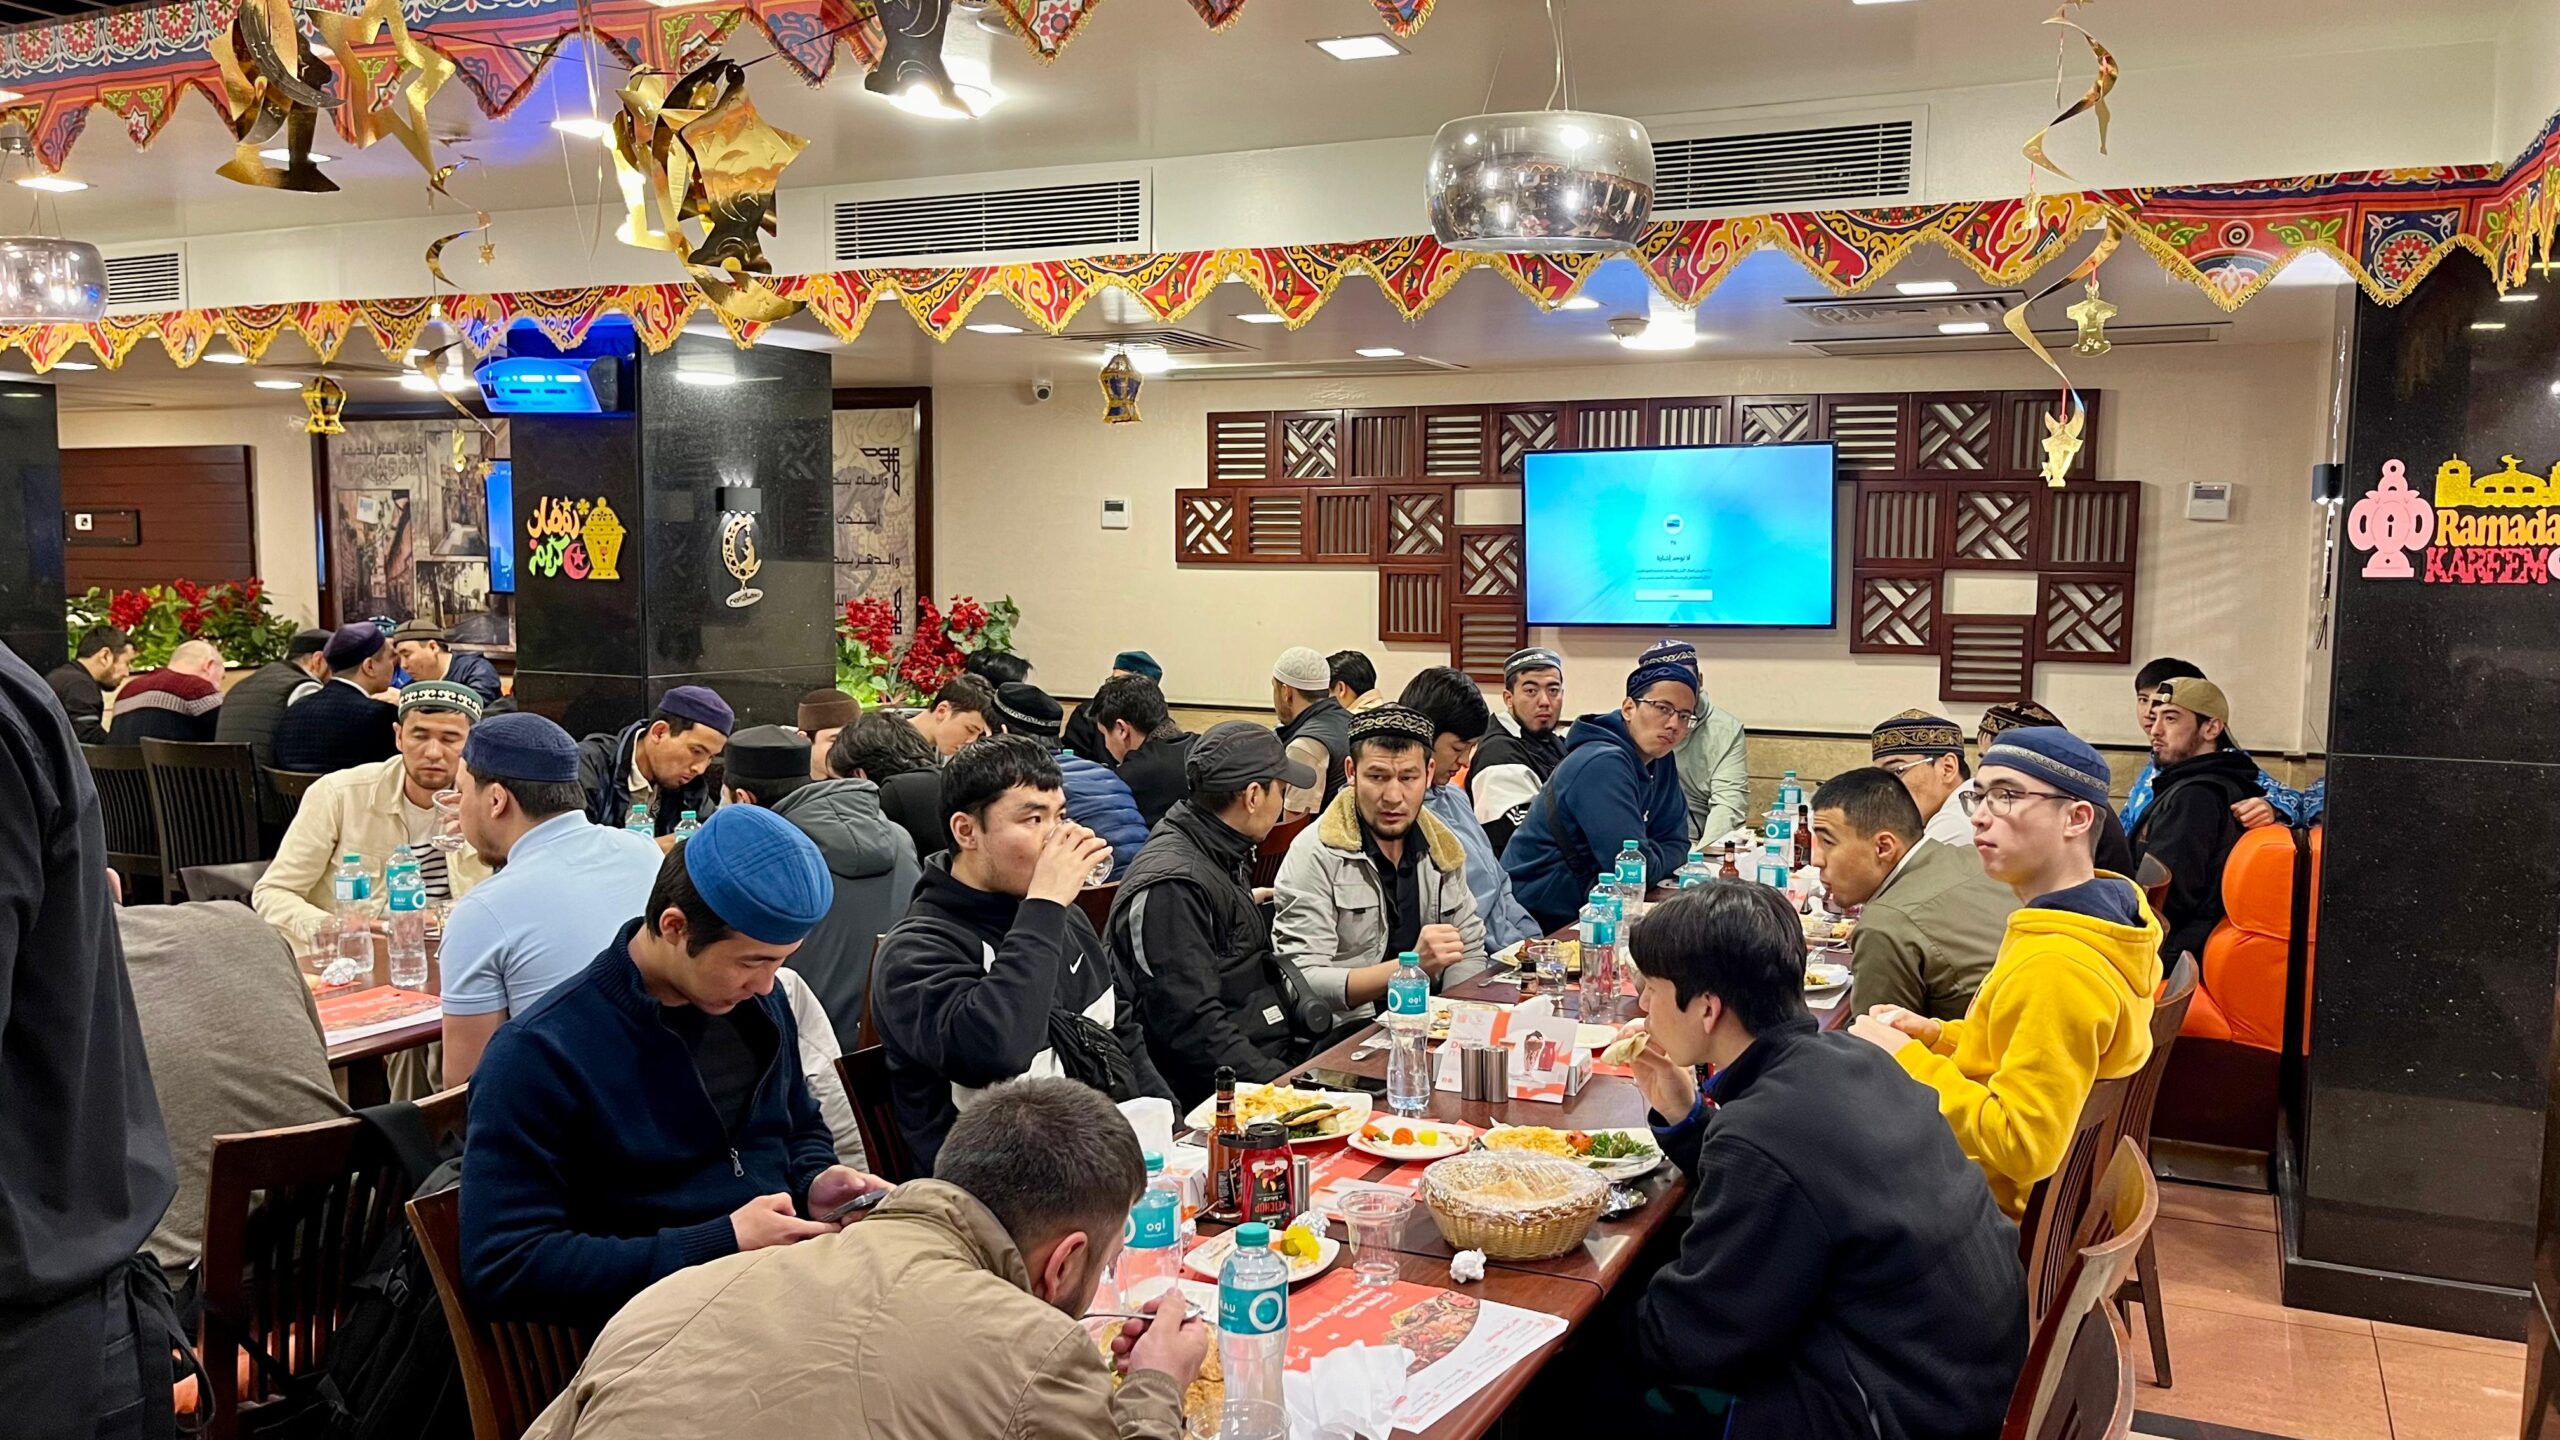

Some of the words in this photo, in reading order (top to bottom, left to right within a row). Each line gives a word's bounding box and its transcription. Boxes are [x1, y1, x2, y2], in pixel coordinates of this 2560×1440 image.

[855, 473, 889, 489] والماء
[526, 496, 580, 540] رمضان
[528, 533, 571, 578] كريم
[2424, 547, 2549, 584] KAREEM
